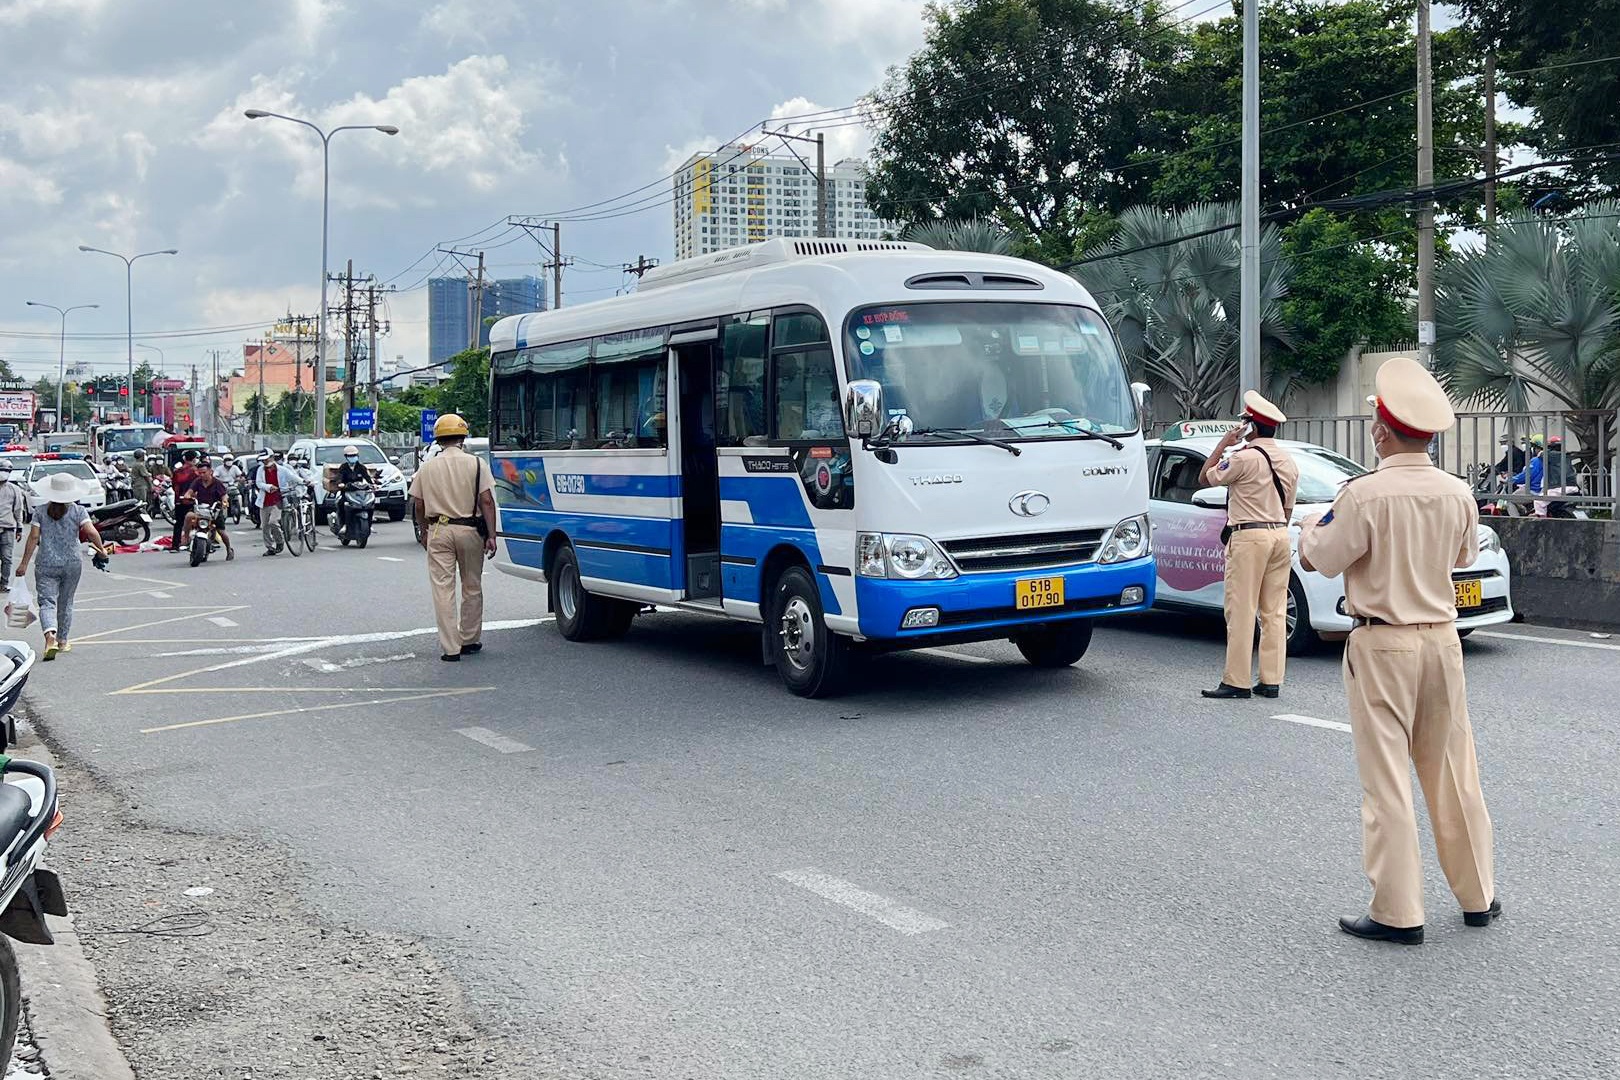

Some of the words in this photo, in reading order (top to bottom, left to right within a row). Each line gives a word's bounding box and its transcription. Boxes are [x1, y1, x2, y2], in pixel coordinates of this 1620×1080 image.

[1082, 465, 1129, 477] COUNTY
[909, 474, 964, 485] THACO
[1030, 579, 1051, 593] 61B
[1455, 583, 1471, 595] 51G
[1021, 592, 1060, 607] 017.90
